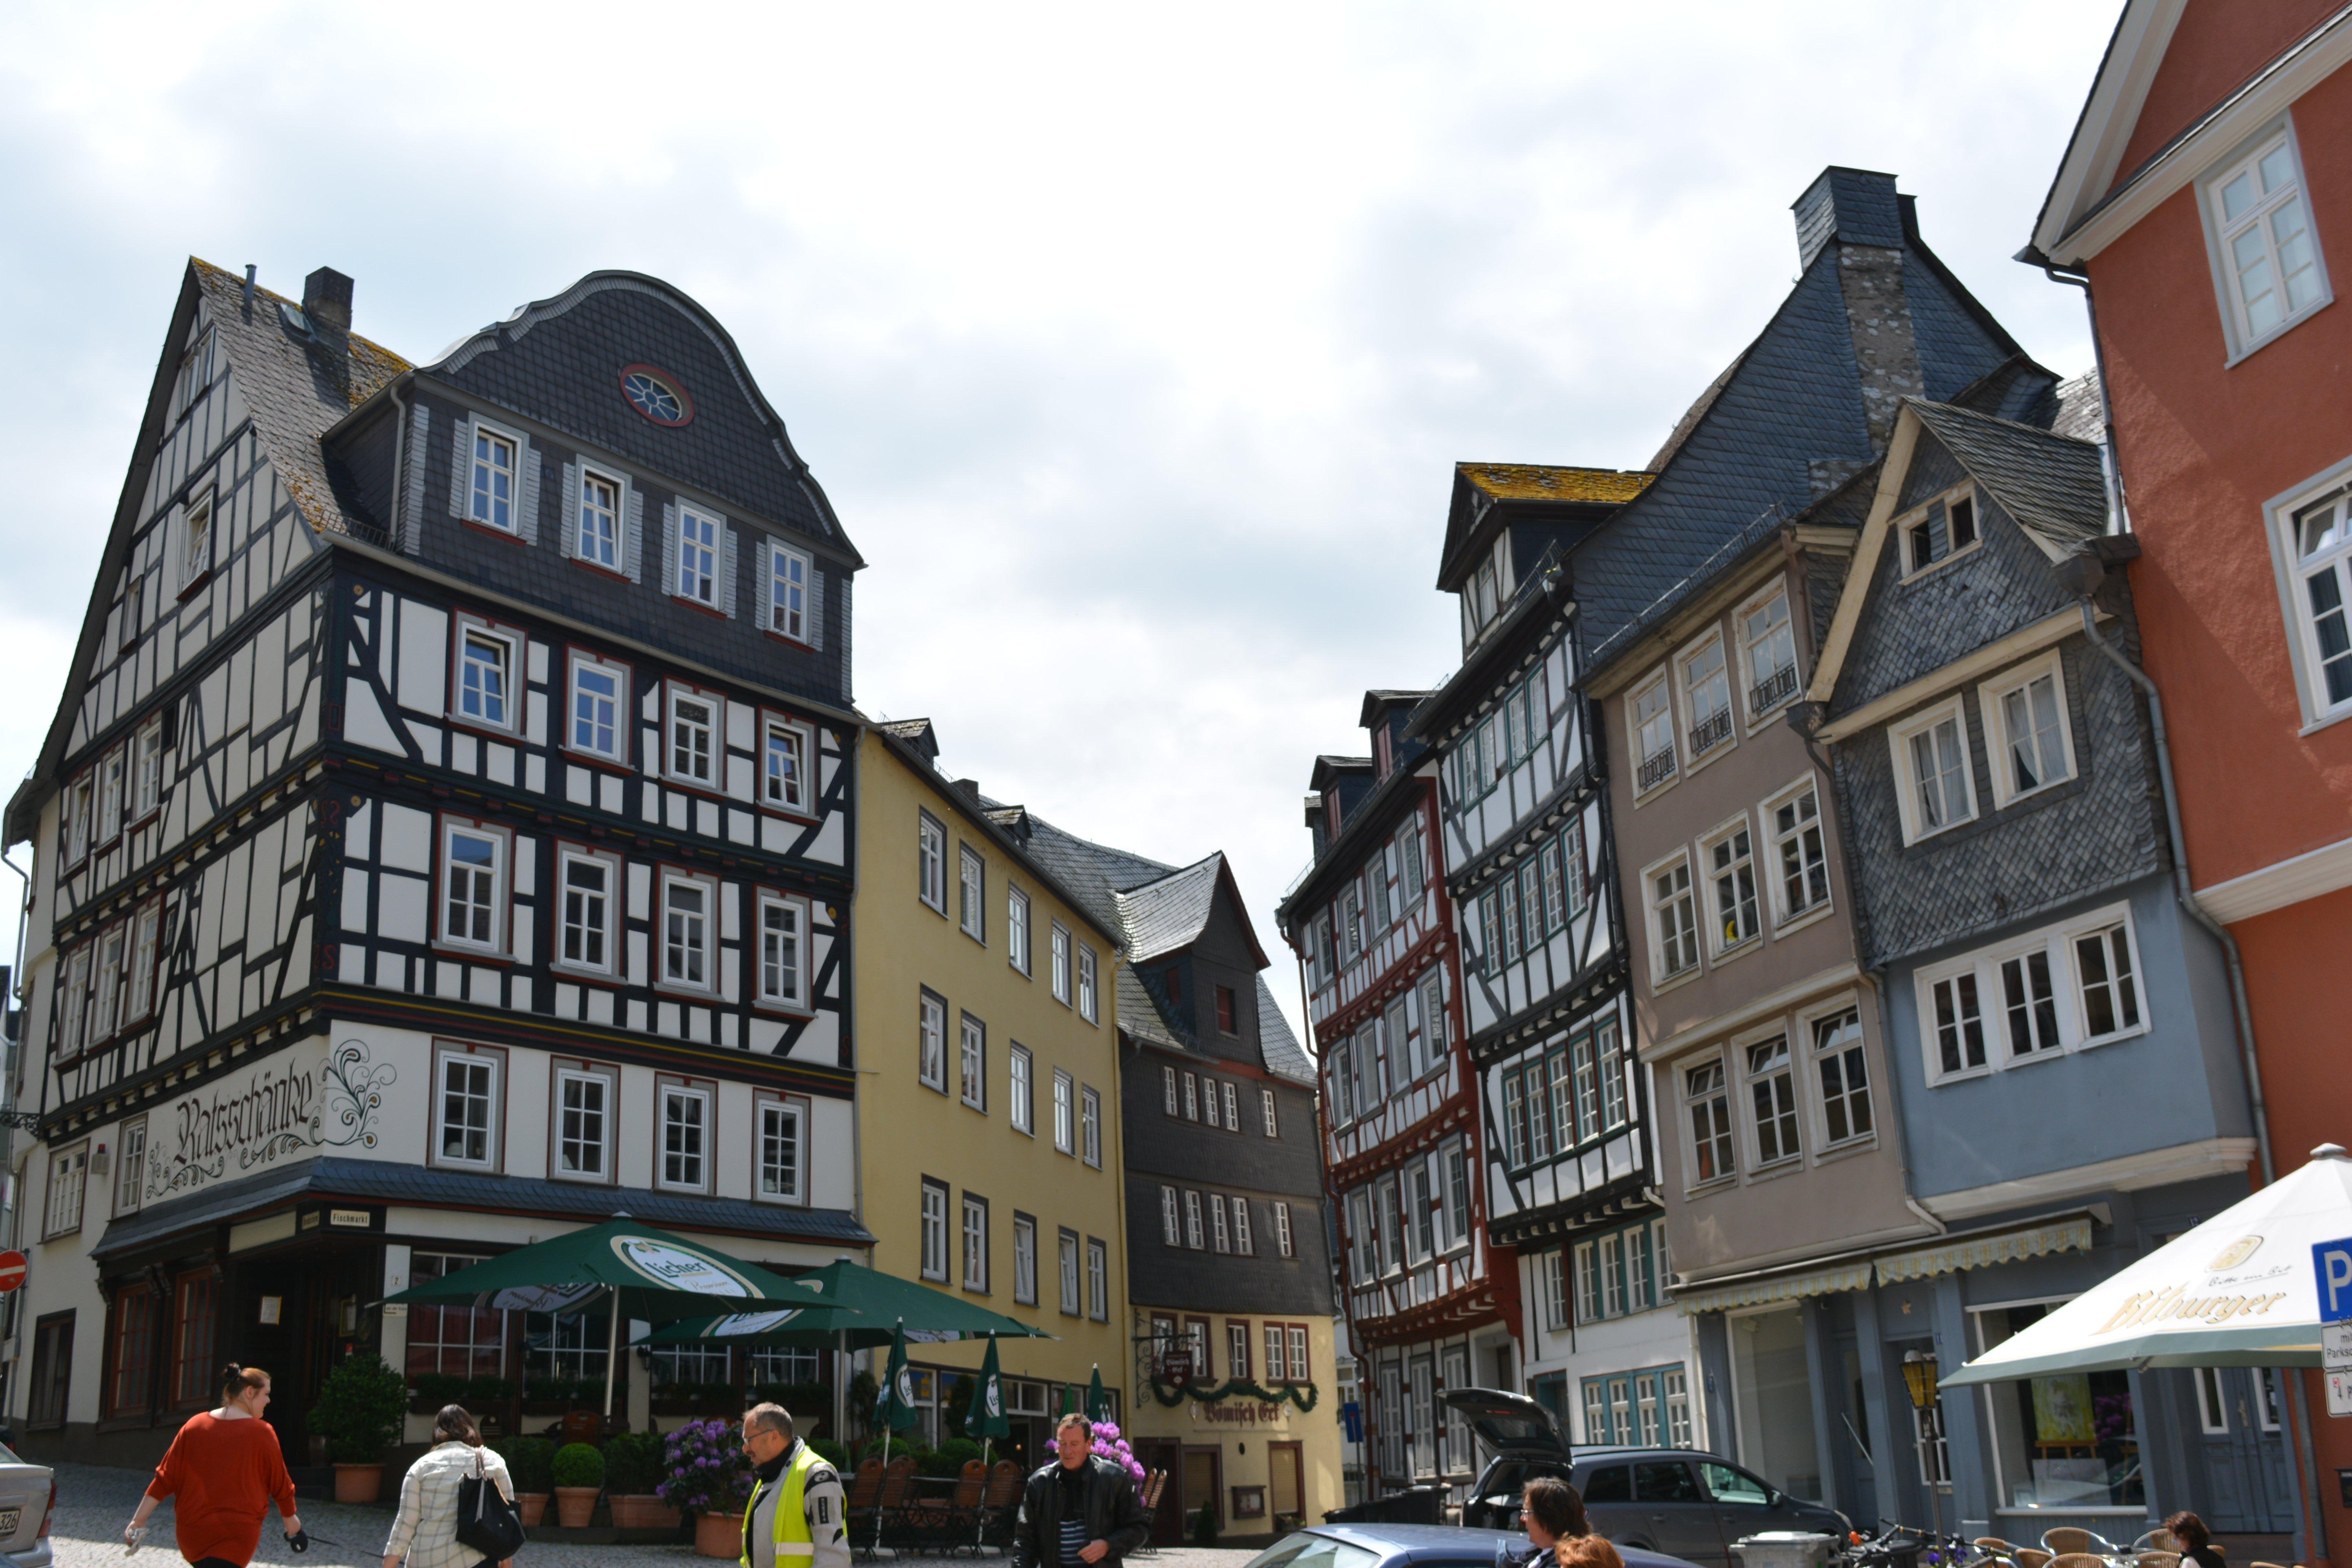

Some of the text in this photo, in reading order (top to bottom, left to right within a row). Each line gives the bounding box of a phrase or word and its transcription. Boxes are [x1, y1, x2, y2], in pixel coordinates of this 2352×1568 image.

[333, 1214, 368, 1223] Fischmarkt
[644, 1259, 707, 1278] Licher
[395, 1277, 399, 1285] 2
[684, 1279, 730, 1290] Premium
[2324, 1250, 2352, 1312] P
[2089, 1280, 2287, 1336] Bitburger
